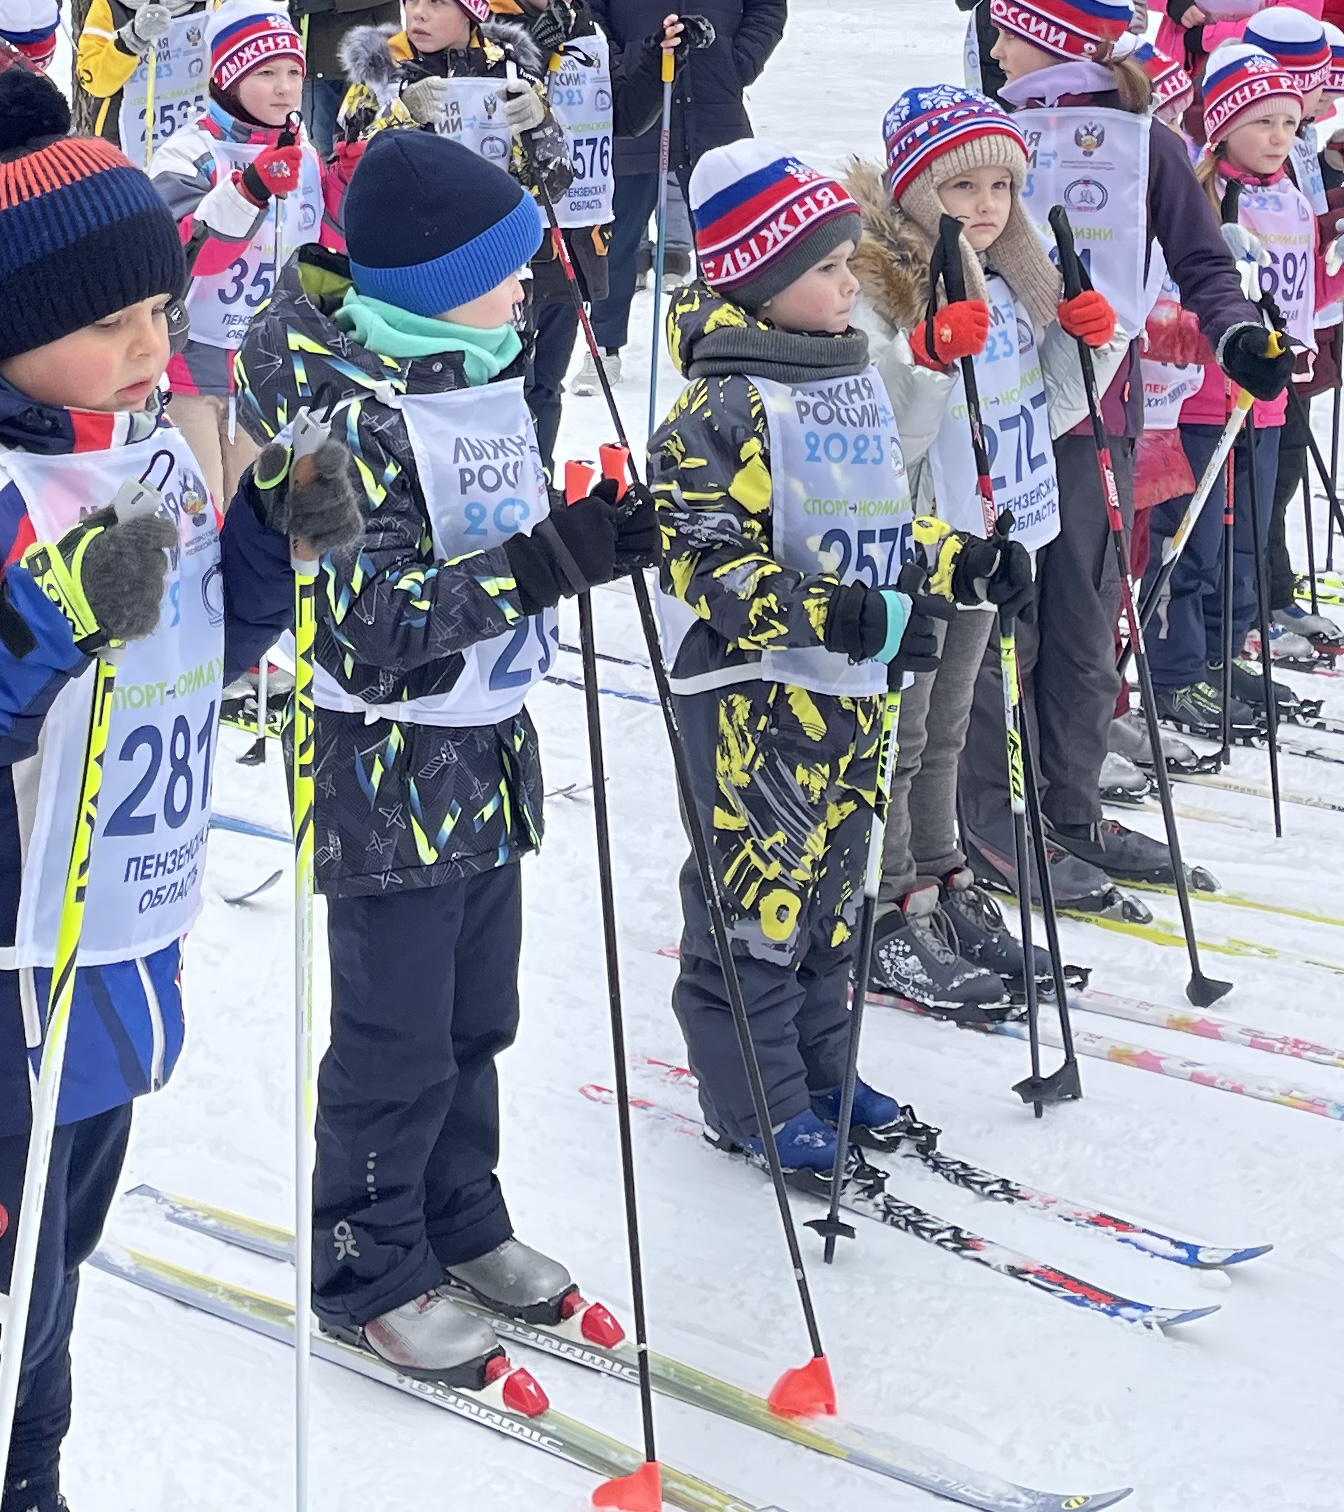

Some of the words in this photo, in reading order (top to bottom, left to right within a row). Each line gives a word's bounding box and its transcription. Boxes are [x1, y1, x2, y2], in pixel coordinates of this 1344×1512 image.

[220, 34, 291, 86] ЛЫЖНЯ
[804, 431, 885, 466] 2023
[803, 497, 849, 518] СПОРТ
[410, 1378, 564, 1455] DYNAMIC
